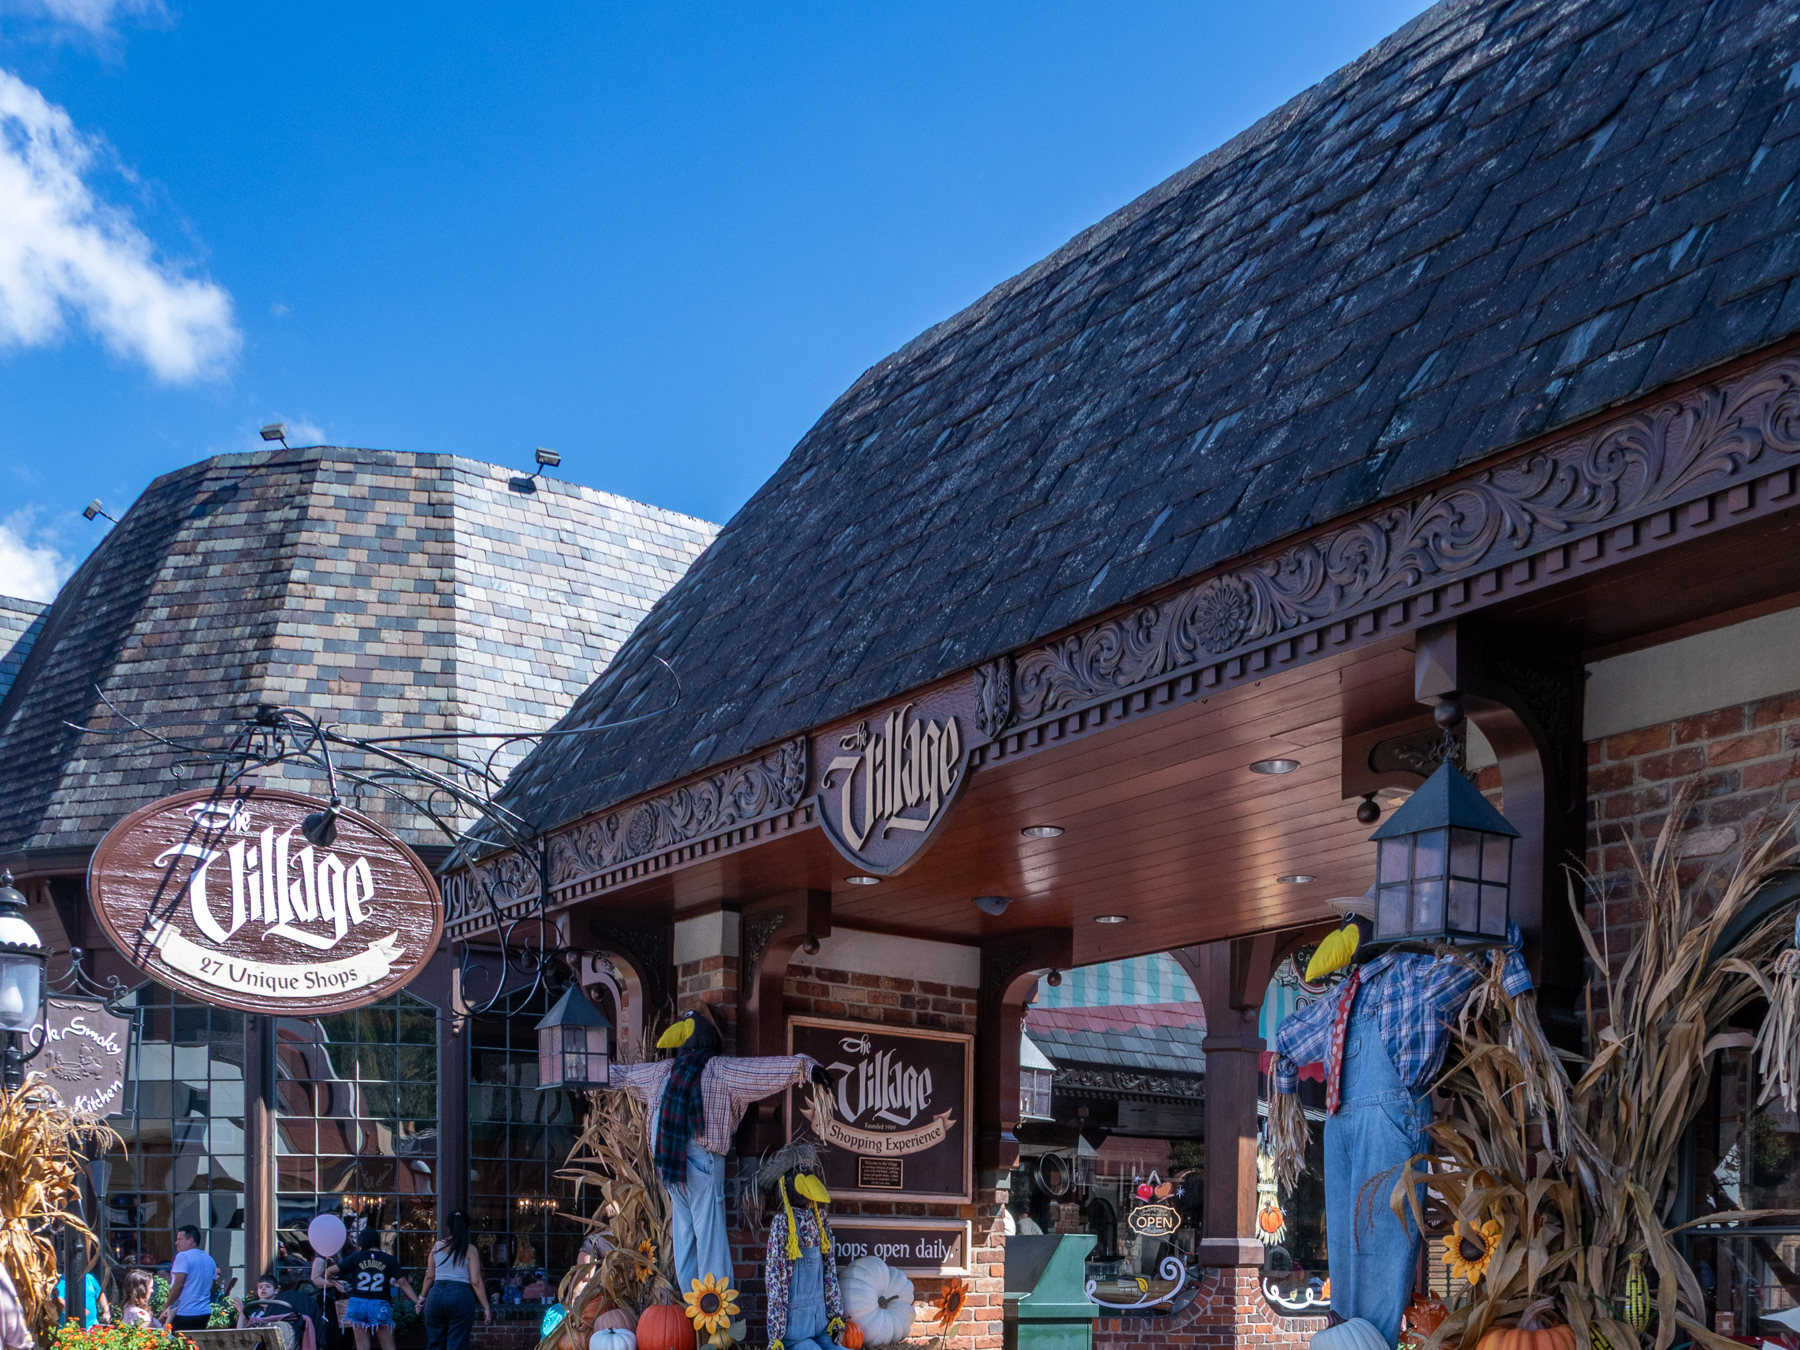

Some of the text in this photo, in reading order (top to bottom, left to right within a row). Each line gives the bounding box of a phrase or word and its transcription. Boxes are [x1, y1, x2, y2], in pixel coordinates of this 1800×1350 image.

[839, 721, 867, 750] The
[821, 703, 959, 851] Village
[185, 798, 251, 832] The
[154, 825, 375, 950] Village
[200, 956, 358, 991] 27 Unique Shops
[29, 1016, 122, 1055] Ole Smoky
[838, 1033, 871, 1056] The
[75, 1080, 123, 1113] Kitchen
[826, 1048, 933, 1126] Village
[829, 1124, 942, 1153] Shopping Experience
[864, 1122, 885, 1131] Founded
[1136, 1216, 1173, 1228] OPEN
[832, 1235, 954, 1264] hops open daily.
[358, 1260, 387, 1271] REDDISH
[356, 1271, 385, 1292] 22
